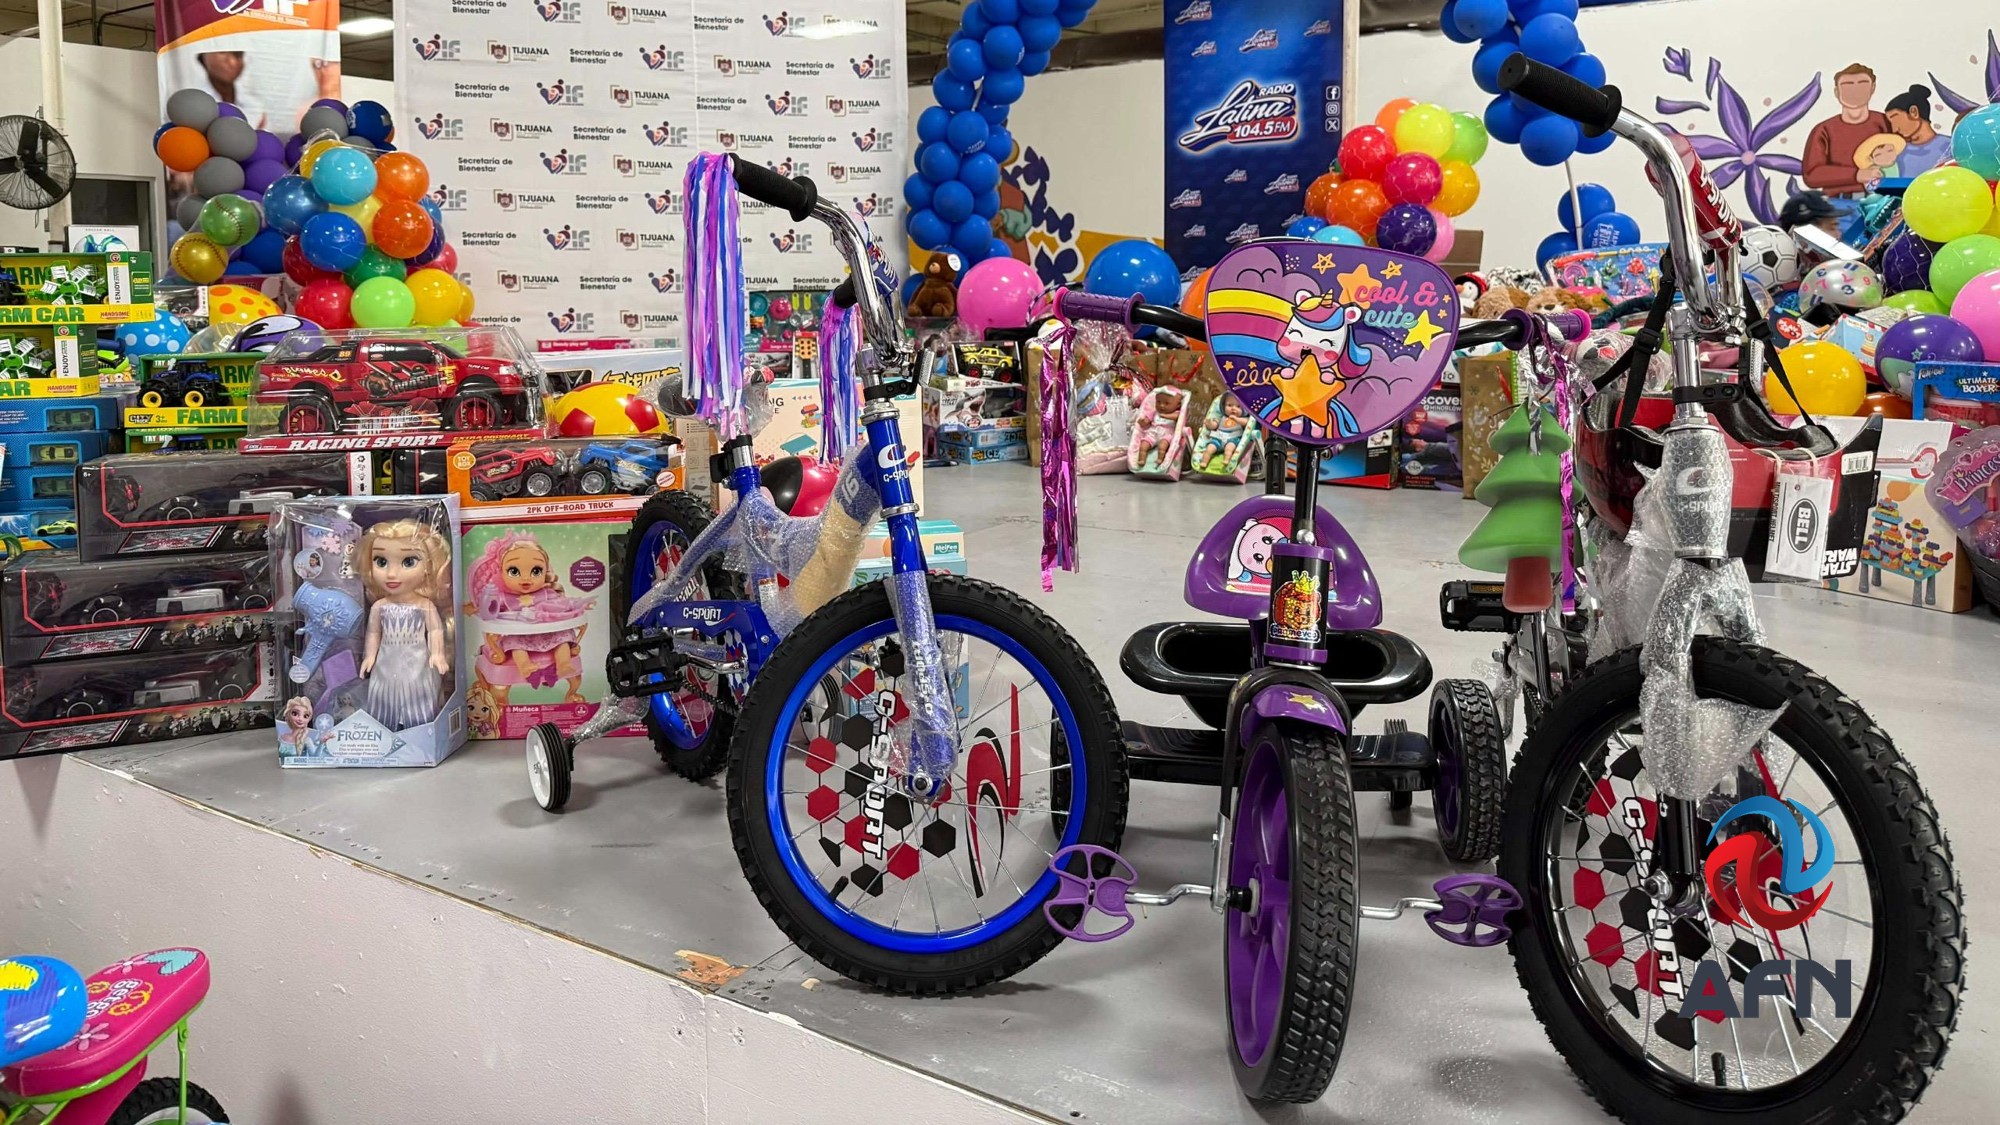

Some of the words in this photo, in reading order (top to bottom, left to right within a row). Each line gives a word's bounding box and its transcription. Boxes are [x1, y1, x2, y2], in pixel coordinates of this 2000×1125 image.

[453, 6, 490, 14] Bienestar
[632, 8, 667, 17] TIJUANA
[694, 16, 732, 24] Secretaría
[512, 47, 549, 55] TIJUANA
[570, 49, 610, 57] Secretaría
[786, 61, 823, 69] Secretaría
[455, 83, 496, 91] Secretaría
[1259, 83, 1294, 97] RADIO
[634, 91, 670, 99] TIJUANA
[697, 96, 735, 104] Secretaría
[1180, 80, 1293, 146] Latina
[573, 126, 614, 134] Secretaría
[1234, 121, 1274, 139] 104.5
[1275, 121, 1291, 133] FM
[789, 135, 825, 143] Secretaría
[458, 157, 500, 165] Secretaría
[638, 161, 672, 170] TIJUANA
[576, 195, 616, 203] Secretaría
[462, 232, 503, 240] Secretaría
[506, 232, 516, 240] de
[4, 266, 49, 286] ARM
[580, 276, 620, 284] Secretaría
[745, 277, 778, 285] TIJUANA
[1355, 281, 1410, 305] cool
[1413, 281, 1438, 307] &
[36, 307, 85, 322] CAR
[1364, 306, 1418, 329] cute
[212, 366, 254, 383] ARM
[1959, 377, 1997, 385] ULTIMATE
[1962, 385, 1996, 393] BOXER
[176, 409, 237, 424] FARM
[289, 438, 371, 450] RACING
[374, 435, 444, 448] SPORT
[526, 506, 543, 514] 2PK
[544, 503, 587, 513] OFF-ROAD
[589, 501, 615, 510] TRUCK
[1795, 507, 1811, 545] BELL
[683, 607, 722, 620] G-SPORT
[337, 730, 382, 741] FROZEN
[1622, 797, 1685, 1001] G-SORT
